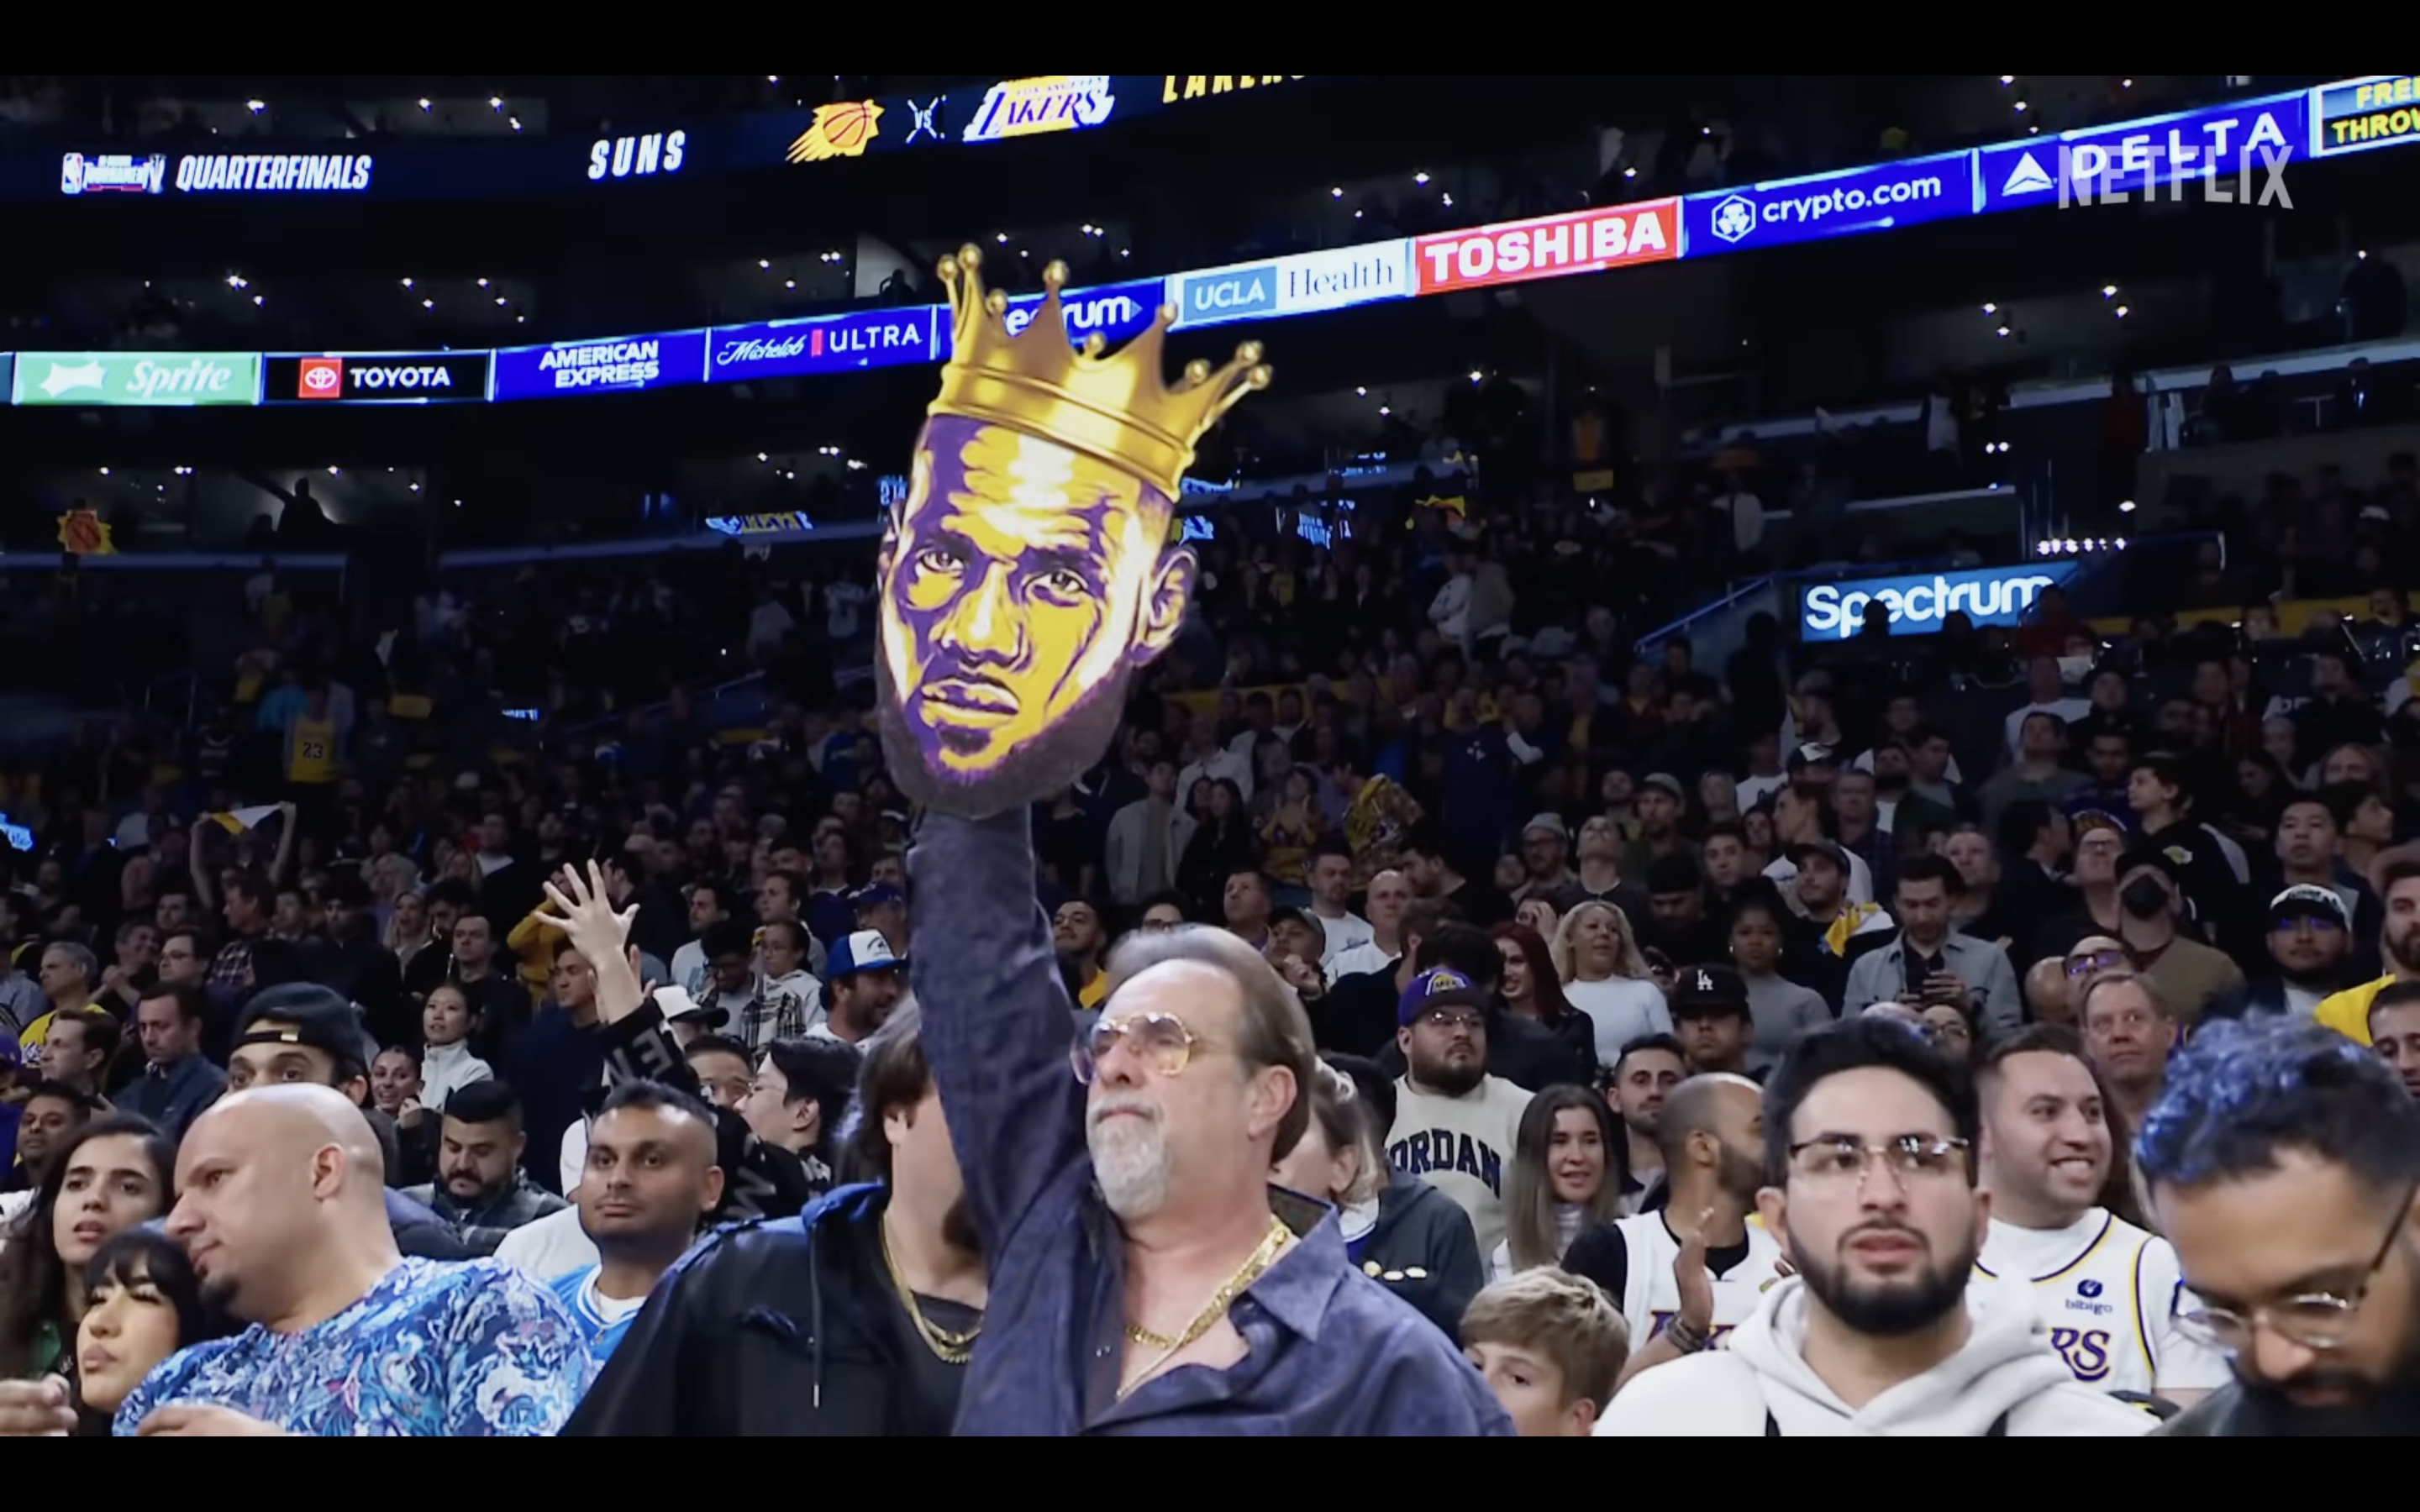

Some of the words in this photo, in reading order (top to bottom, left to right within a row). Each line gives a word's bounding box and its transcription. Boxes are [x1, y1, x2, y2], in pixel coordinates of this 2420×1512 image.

[914, 109, 932, 130] VS
[588, 129, 685, 181] SUNS
[2072, 111, 2286, 181] DELTA
[176, 155, 372, 192] QUARTERFINALS
[1762, 172, 1942, 224] crypto.com
[1425, 211, 1666, 283] TOSHIBA
[1194, 278, 1266, 311] UCLA
[1290, 256, 1394, 299] Health
[539, 340, 660, 370] AMERICAN
[717, 334, 806, 366] Michelob
[829, 323, 923, 353] ULTRA
[126, 359, 232, 403] Sprite
[350, 365, 451, 389] TOYOTA
[555, 360, 660, 388] EXPRESS
[1806, 575, 2054, 639] Spectrum
[302, 742, 324, 759] 23
[1697, 969, 1714, 991] LA
[1388, 1127, 1502, 1201] ORDAN
[2065, 1297, 2113, 1316] bibigo
